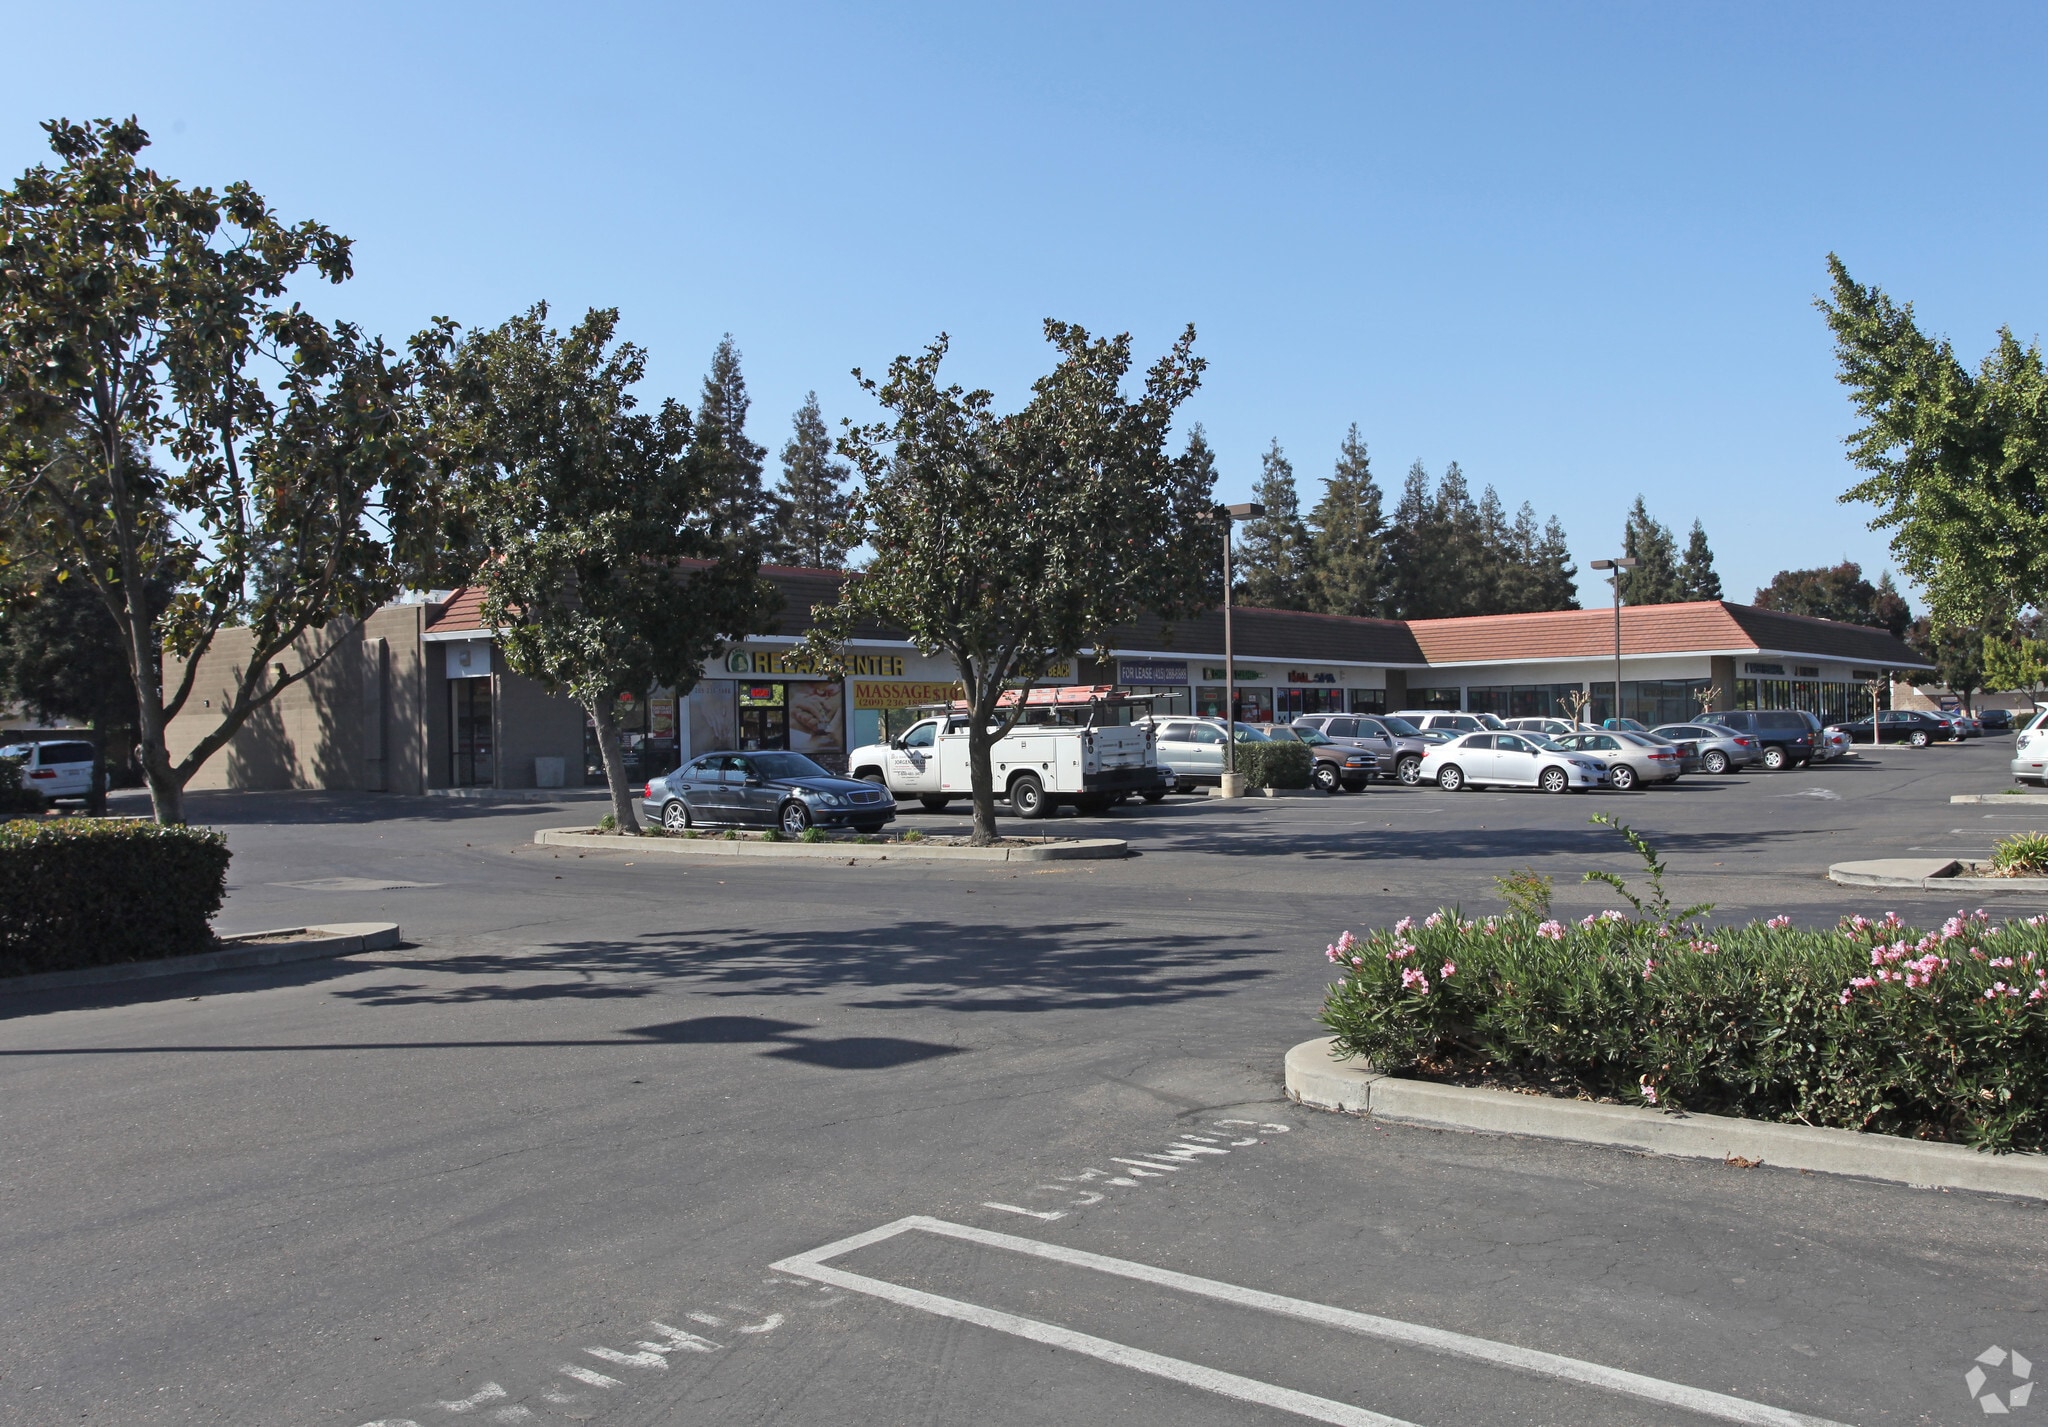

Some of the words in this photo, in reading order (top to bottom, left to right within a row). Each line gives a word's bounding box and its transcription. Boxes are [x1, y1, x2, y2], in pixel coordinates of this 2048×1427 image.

[1122, 667, 1134, 679] FOR
[1135, 667, 1152, 679] LEASE
[855, 684, 931, 699] MASSAGE
